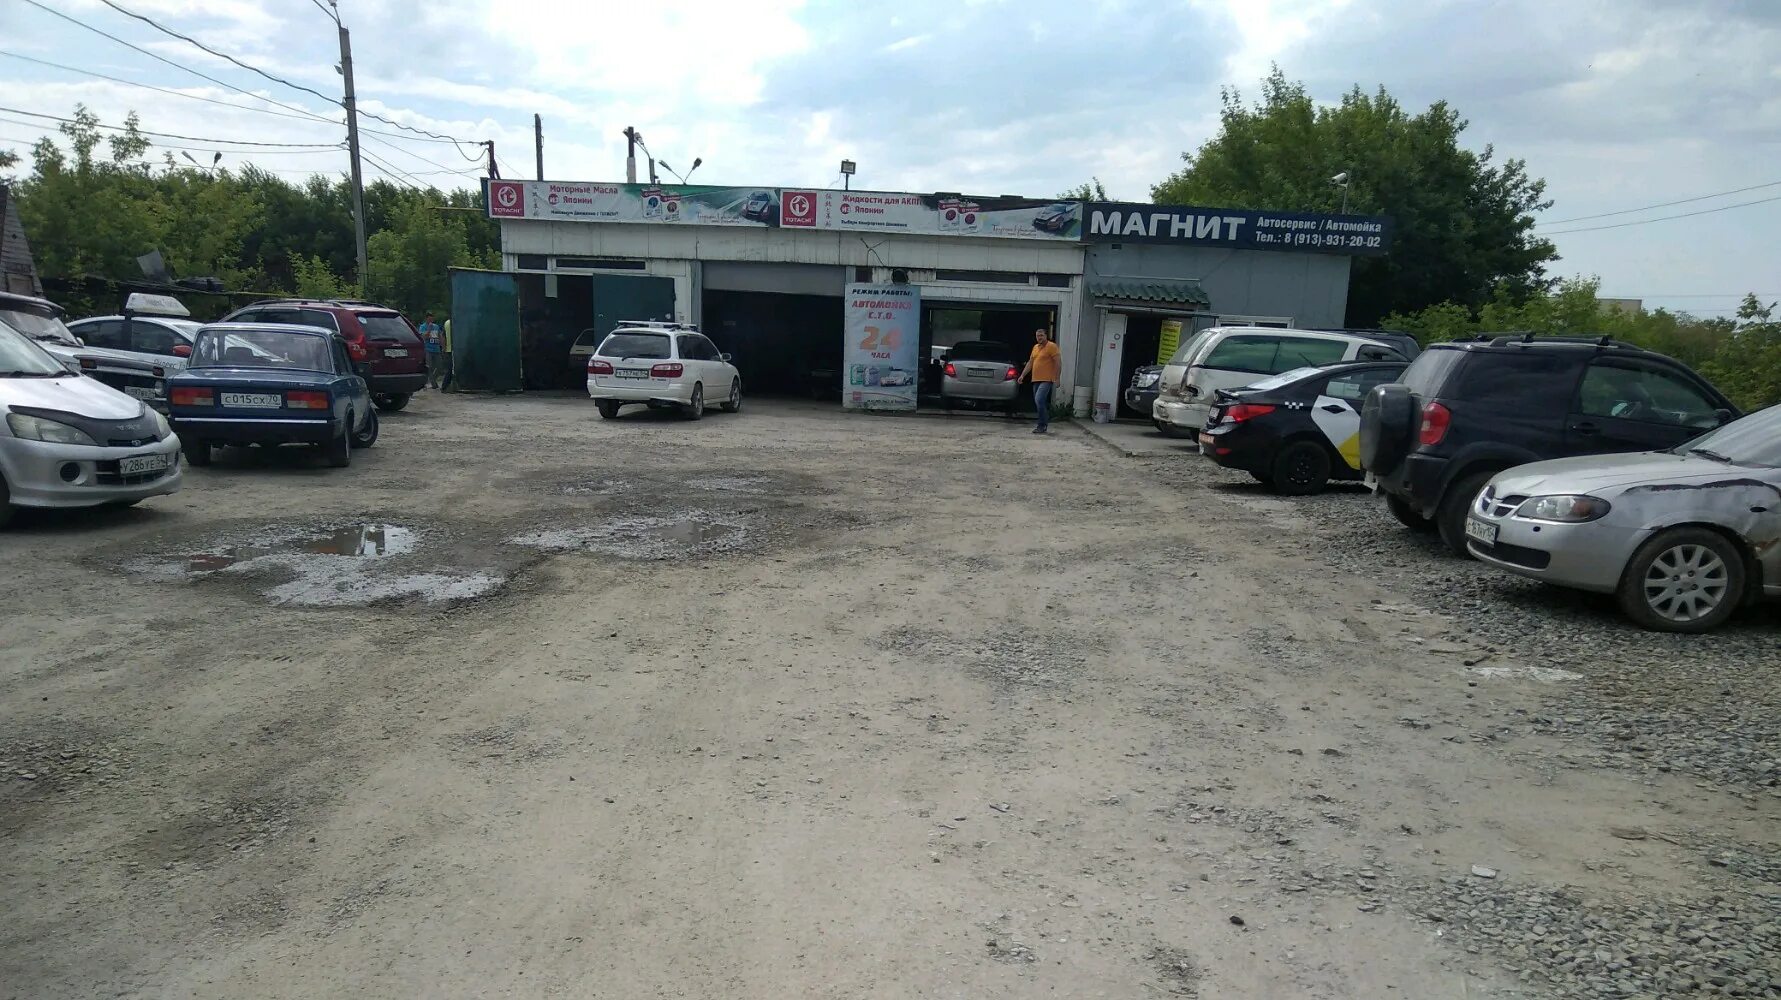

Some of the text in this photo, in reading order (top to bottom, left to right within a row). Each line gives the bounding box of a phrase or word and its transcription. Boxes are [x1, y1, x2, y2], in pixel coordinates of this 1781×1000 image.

[550, 185, 618, 195] Моторные Масла
[563, 196, 592, 205] Японии
[842, 194, 883, 204] Жидкости
[855, 206, 884, 214] Японии
[1090, 211, 1246, 240] МАГНИТ
[1257, 216, 1382, 232] Автосервис / Автомойка
[1255, 231, 1381, 247] Тел.: 8 (913)-931-20-02
[860, 326, 902, 350] 24
